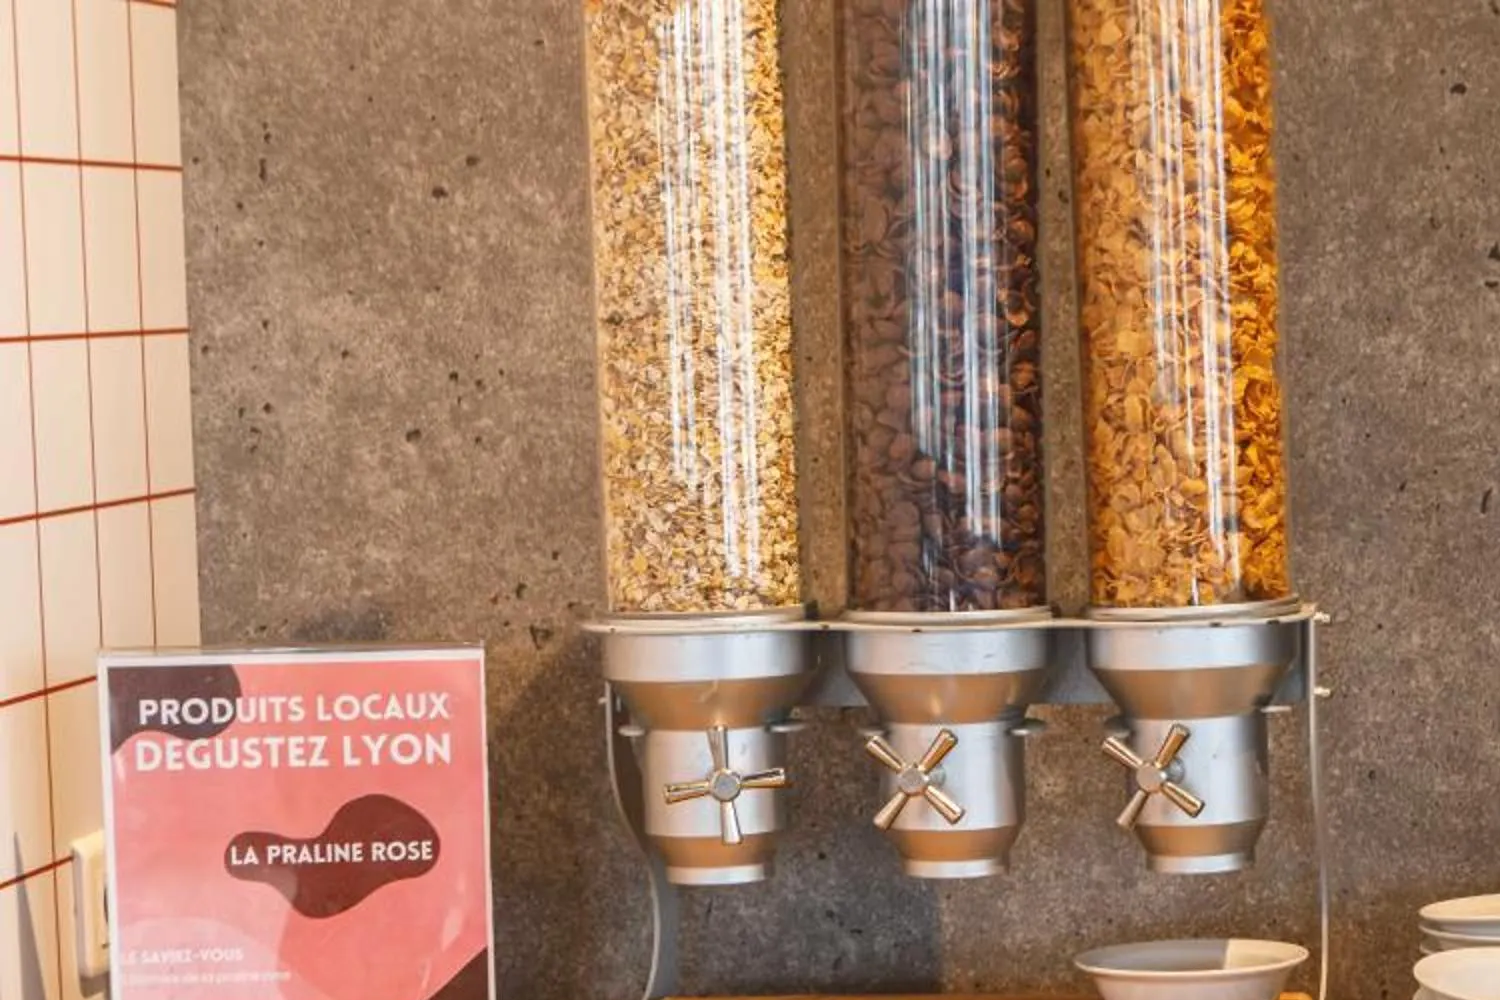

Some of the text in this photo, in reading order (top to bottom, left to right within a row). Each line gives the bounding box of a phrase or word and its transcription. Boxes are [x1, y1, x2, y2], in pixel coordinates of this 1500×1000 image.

[138, 693, 450, 725] PRODUITS LOCAUX
[135, 733, 451, 771] DEGUSTEZ LYON
[231, 841, 433, 865] LA PRALINE ROSE
